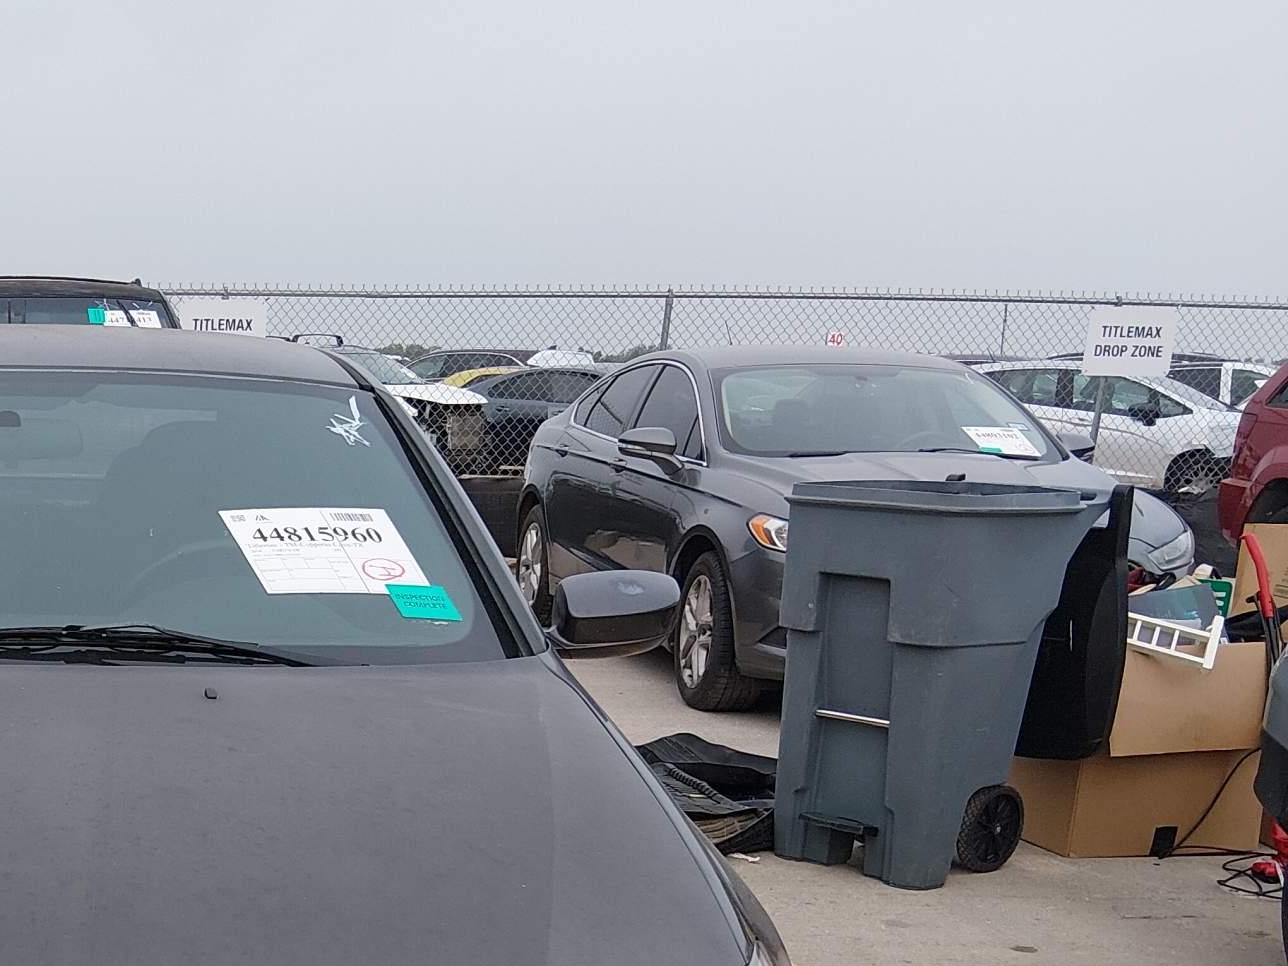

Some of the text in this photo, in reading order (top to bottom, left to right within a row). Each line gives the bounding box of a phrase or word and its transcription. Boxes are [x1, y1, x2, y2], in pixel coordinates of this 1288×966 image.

[192, 318, 253, 331] TITLEMAX
[1101, 325, 1163, 338] TITLEMAX
[828, 333, 843, 345] 40
[1093, 344, 1164, 358] DROP ZONE
[252, 526, 382, 543] 44815960
